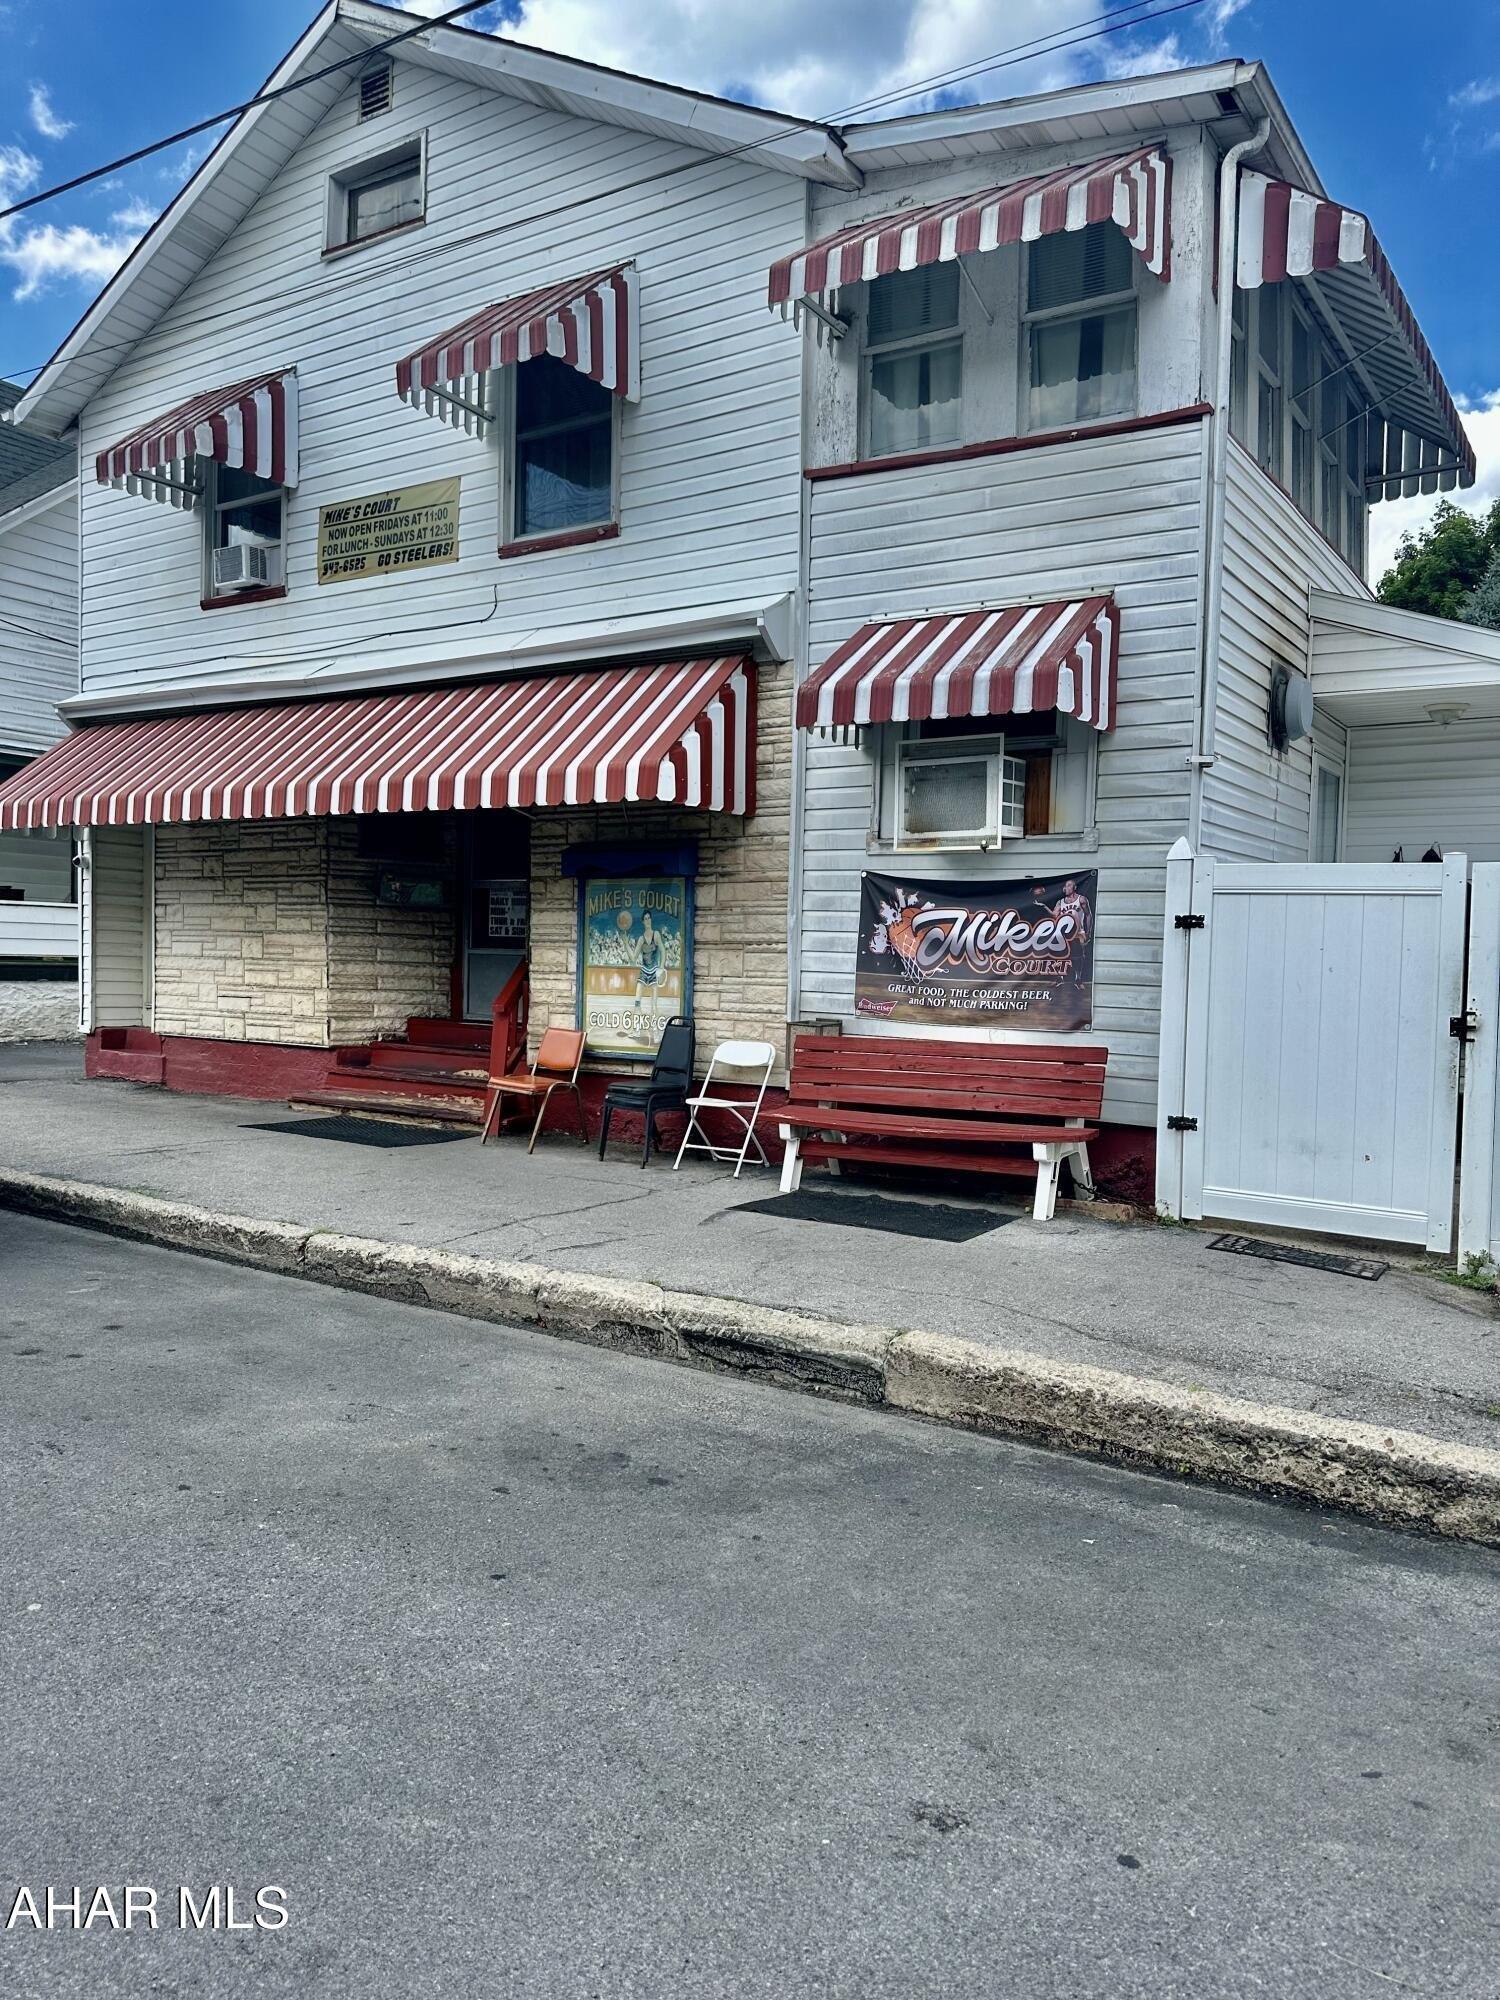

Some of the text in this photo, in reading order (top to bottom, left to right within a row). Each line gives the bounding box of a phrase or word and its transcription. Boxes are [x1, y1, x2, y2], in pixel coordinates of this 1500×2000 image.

[324, 497, 401, 524] MIKE'S COURT
[328, 507, 448, 541] NOW OPEN FRIDAYS AT 11:00
[322, 544, 338, 557] FOR
[340, 538, 368, 554] LUNCH
[375, 530, 415, 547] SUNDAYS
[417, 527, 428, 540] AT
[430, 522, 453, 538] 12:30
[378, 541, 454, 567] GO STEELERS!
[322, 557, 366, 576] 943-6525
[589, 888, 680, 917] MIKE'S COURT
[910, 908, 1076, 968] Mikes
[991, 956, 1072, 976] COURT
[888, 983, 1053, 1001] GREAT FOOD, THE COLDEST BEER,
[908, 996, 1028, 1010] and NOT MUCH PARKING!
[858, 1001, 893, 1012] Budweiser
[590, 1012, 620, 1028] COLD
[622, 1010, 632, 1030] 6
[633, 1014, 650, 1030] PKS
